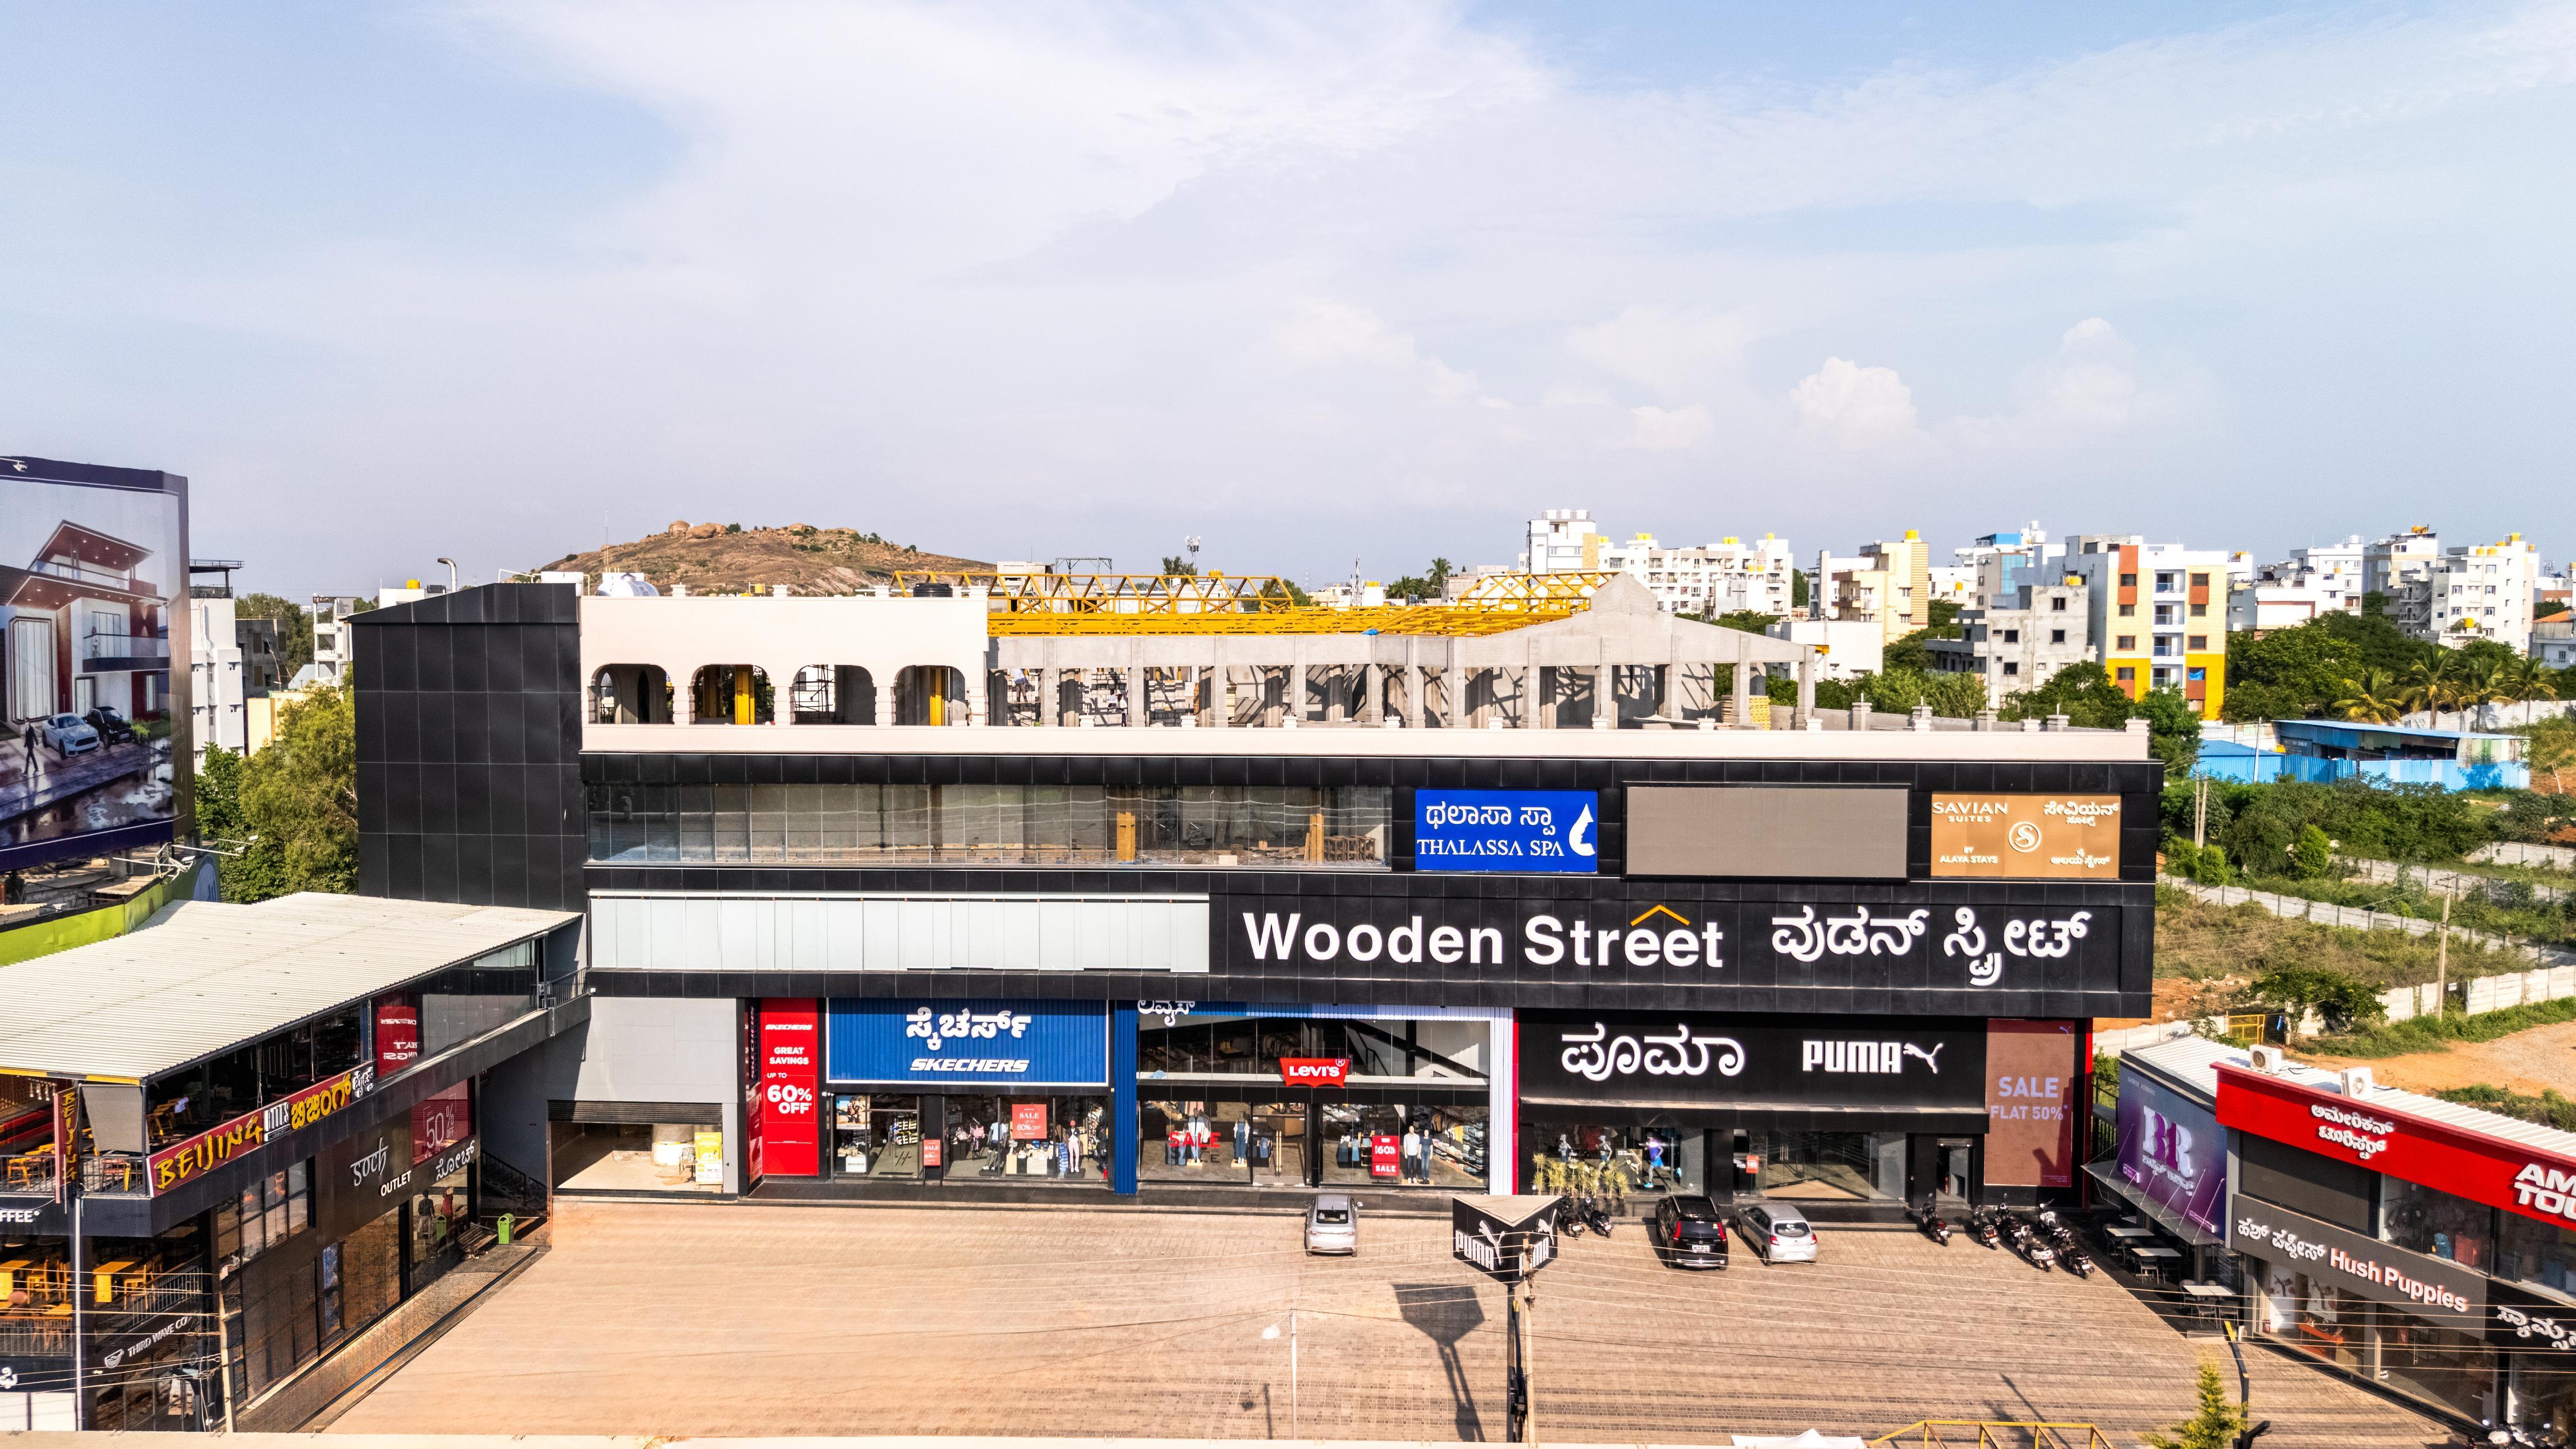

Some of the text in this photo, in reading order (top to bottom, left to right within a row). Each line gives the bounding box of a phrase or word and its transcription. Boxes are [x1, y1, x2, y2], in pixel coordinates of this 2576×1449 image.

[1932, 802, 2008, 815] SAVIAN
[1416, 839, 1564, 856] THALASSA SPA
[1939, 856, 1999, 864] ALAYA STAYS
[1242, 913, 1723, 968] Wooden Street
[1772, 905, 1930, 962] ವುಡನ್
[769, 1057, 809, 1065] SAVINGS
[1561, 1022, 1746, 1082] ಪೂಮಾ
[1802, 1040, 1902, 1074] PUMA
[910, 1059, 1030, 1072] SKECHERS
[767, 1085, 812, 1103] 60%
[1998, 1076, 2059, 1098] SALE
[1990, 1105, 2028, 1120] FLAT
[447, 1127, 455, 1139] OFF
[1168, 1131, 1221, 1148] SALE
[153, 1115, 263, 1190] BEIJING
[1375, 1164, 1397, 1172] SALE
[379, 1170, 412, 1197] OUTLET
[1455, 1229, 1495, 1272] PUMA
[2330, 1247, 2470, 1313] Hush Puppies
[127, 1337, 152, 1357] THIRD
[152, 1323, 175, 1343] WAVE
